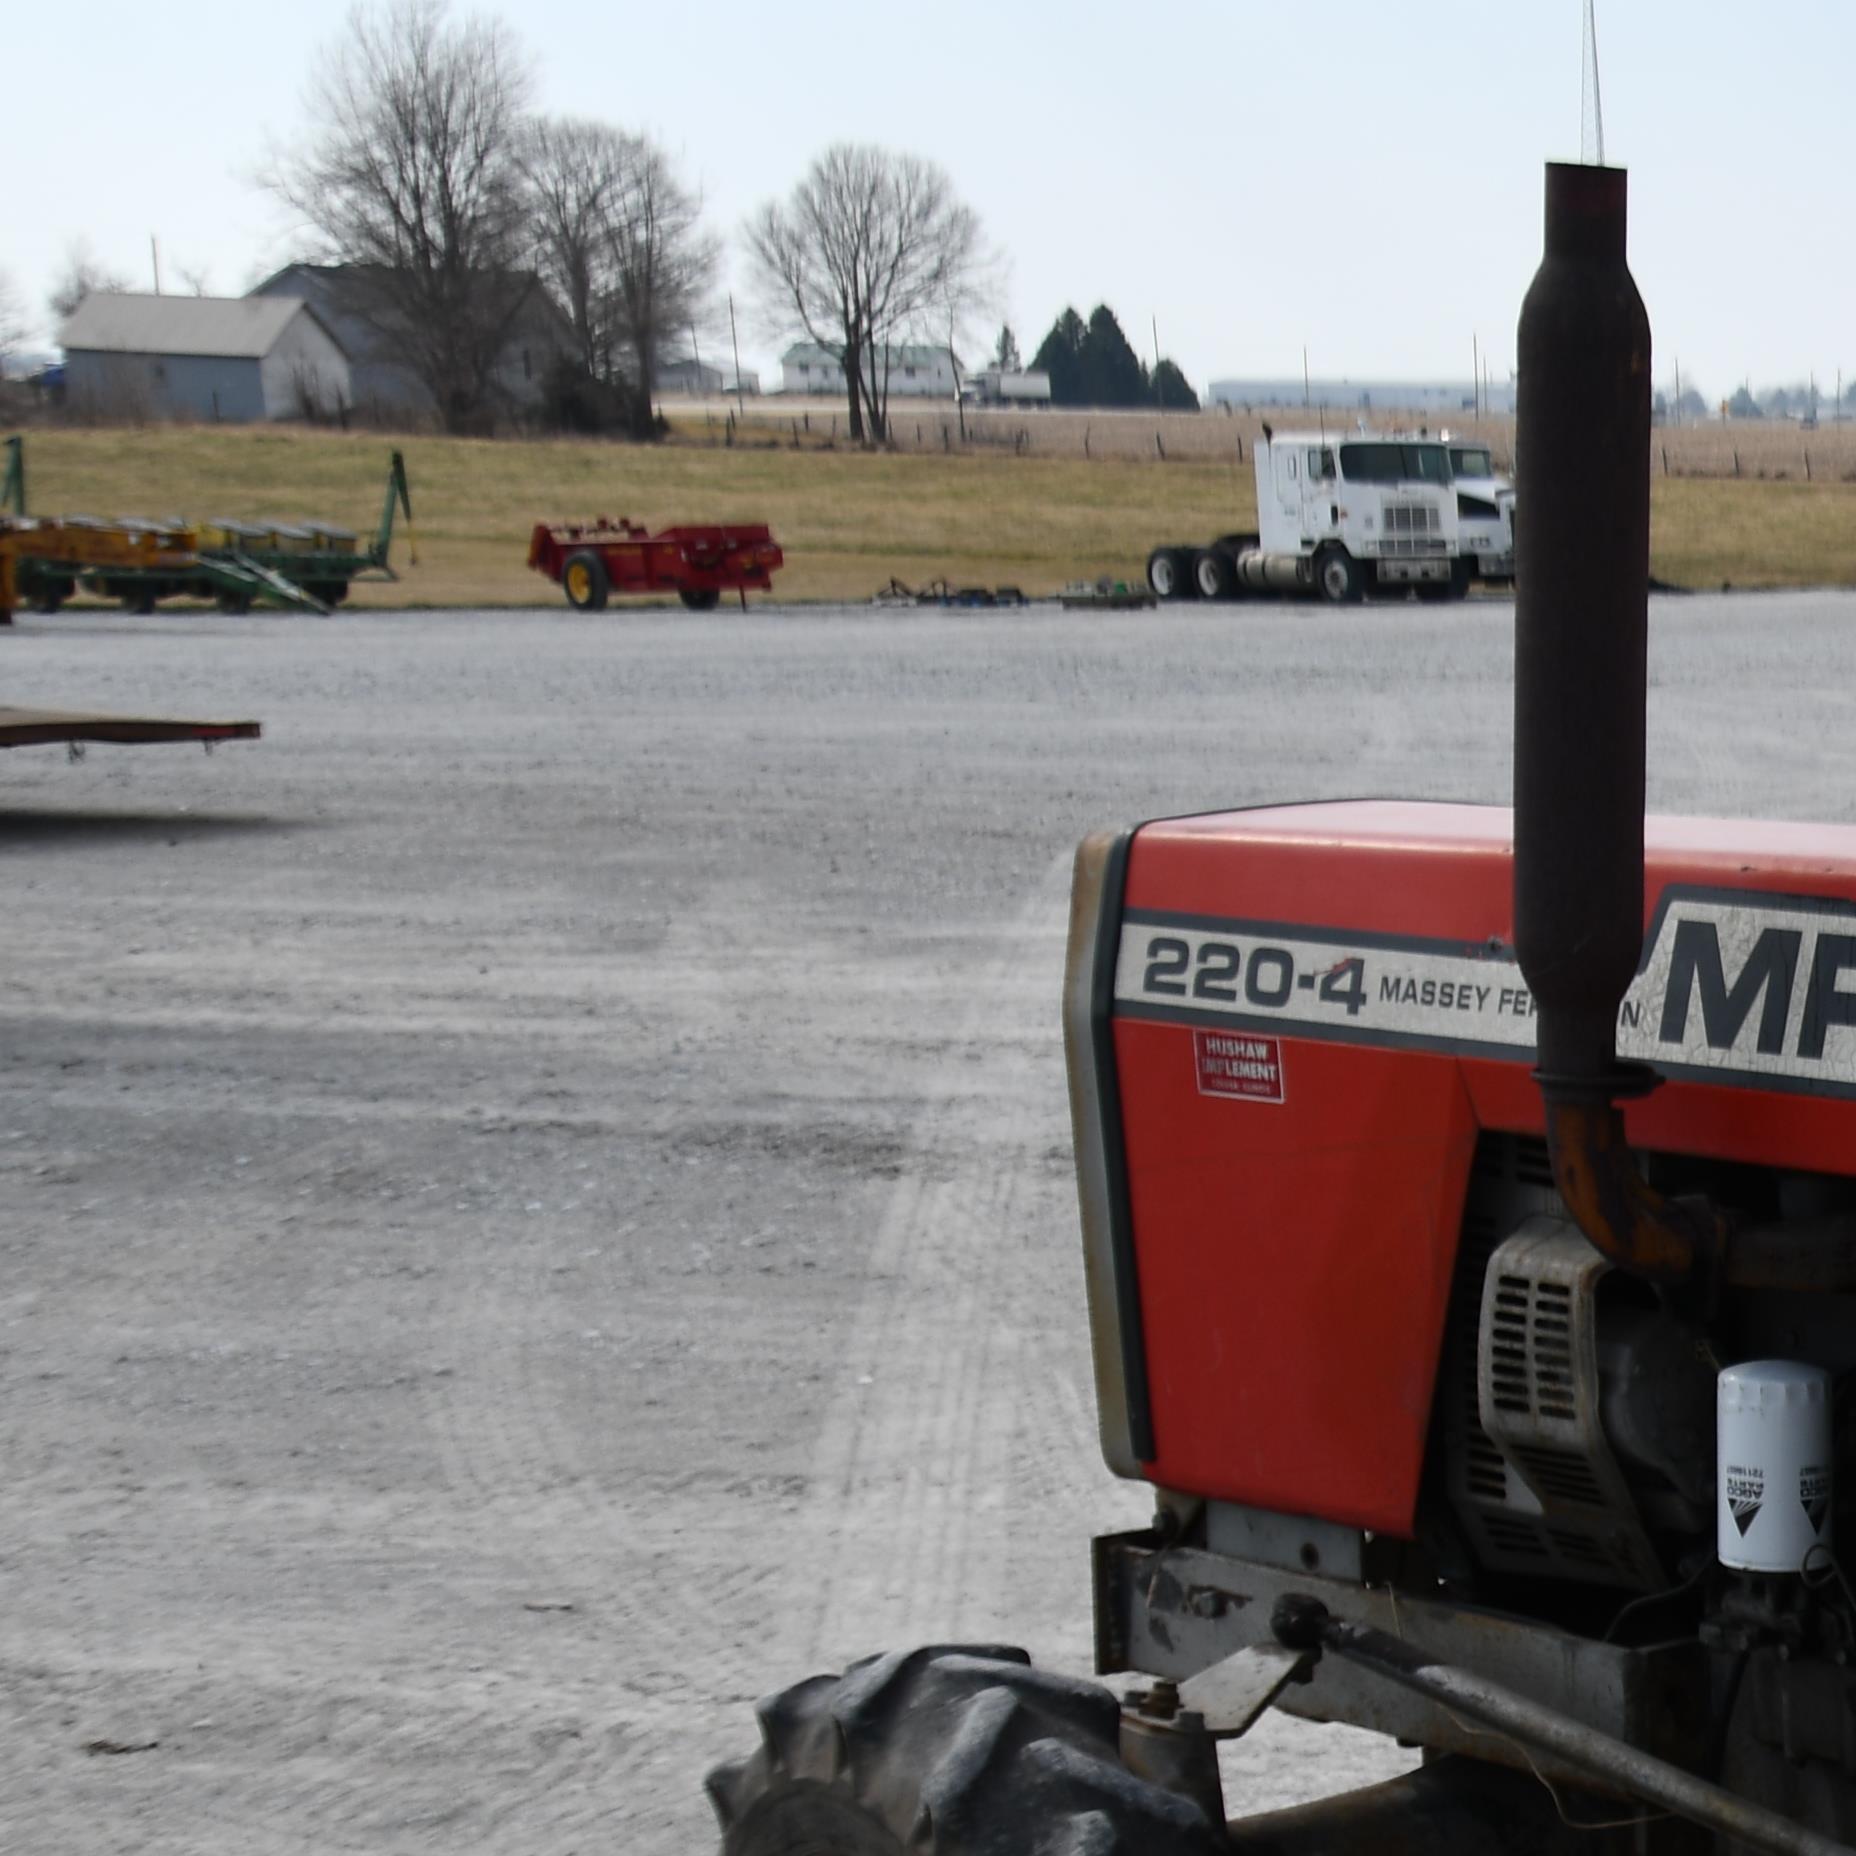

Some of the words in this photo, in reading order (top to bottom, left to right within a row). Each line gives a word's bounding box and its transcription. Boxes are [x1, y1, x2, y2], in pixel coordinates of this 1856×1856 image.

[1143, 937, 1367, 1015] 220-4
[1379, 976, 1491, 1012] MASSEY
[1205, 1036, 1268, 1060] HUSHAW
[1202, 1057, 1277, 1082] IMPLEMENT
